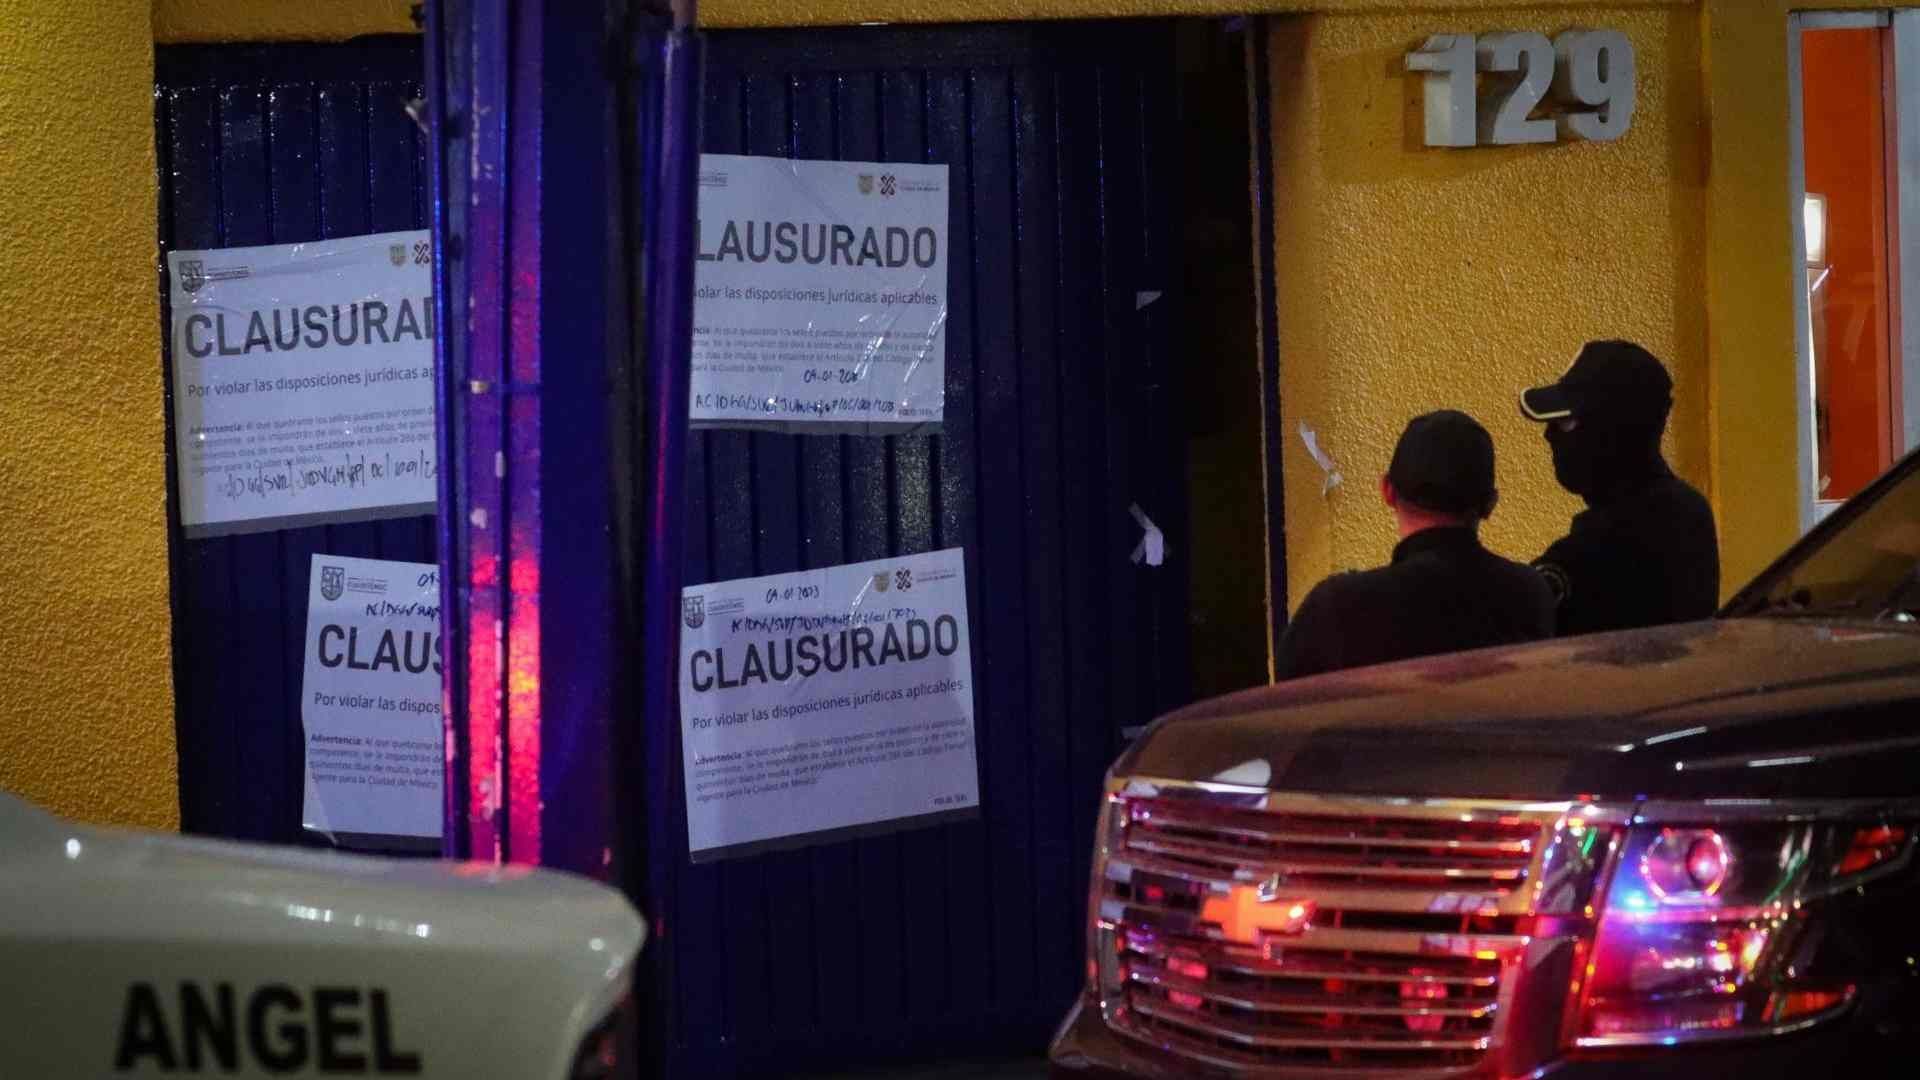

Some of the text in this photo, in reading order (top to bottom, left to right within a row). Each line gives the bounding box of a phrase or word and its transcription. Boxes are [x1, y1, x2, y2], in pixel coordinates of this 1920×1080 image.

[1405, 30, 1636, 147] 129
[724, 285, 741, 298] las
[745, 286, 825, 303] disposiciones
[828, 288, 877, 304] jurídicas
[880, 291, 937, 306] aplicables
[188, 383, 209, 398] Por
[214, 380, 250, 396] violar
[254, 378, 273, 393] las
[276, 373, 361, 394] disposiciones
[364, 367, 418, 387] jurídicas
[690, 613, 960, 693] CLAUSURADO
[314, 691, 336, 706] Por
[339, 695, 374, 709] violar
[378, 696, 397, 711] las
[692, 677, 964, 729] Por violar las disposiciones jurídicas aplicables
[113, 981, 424, 1074] ANGEL
